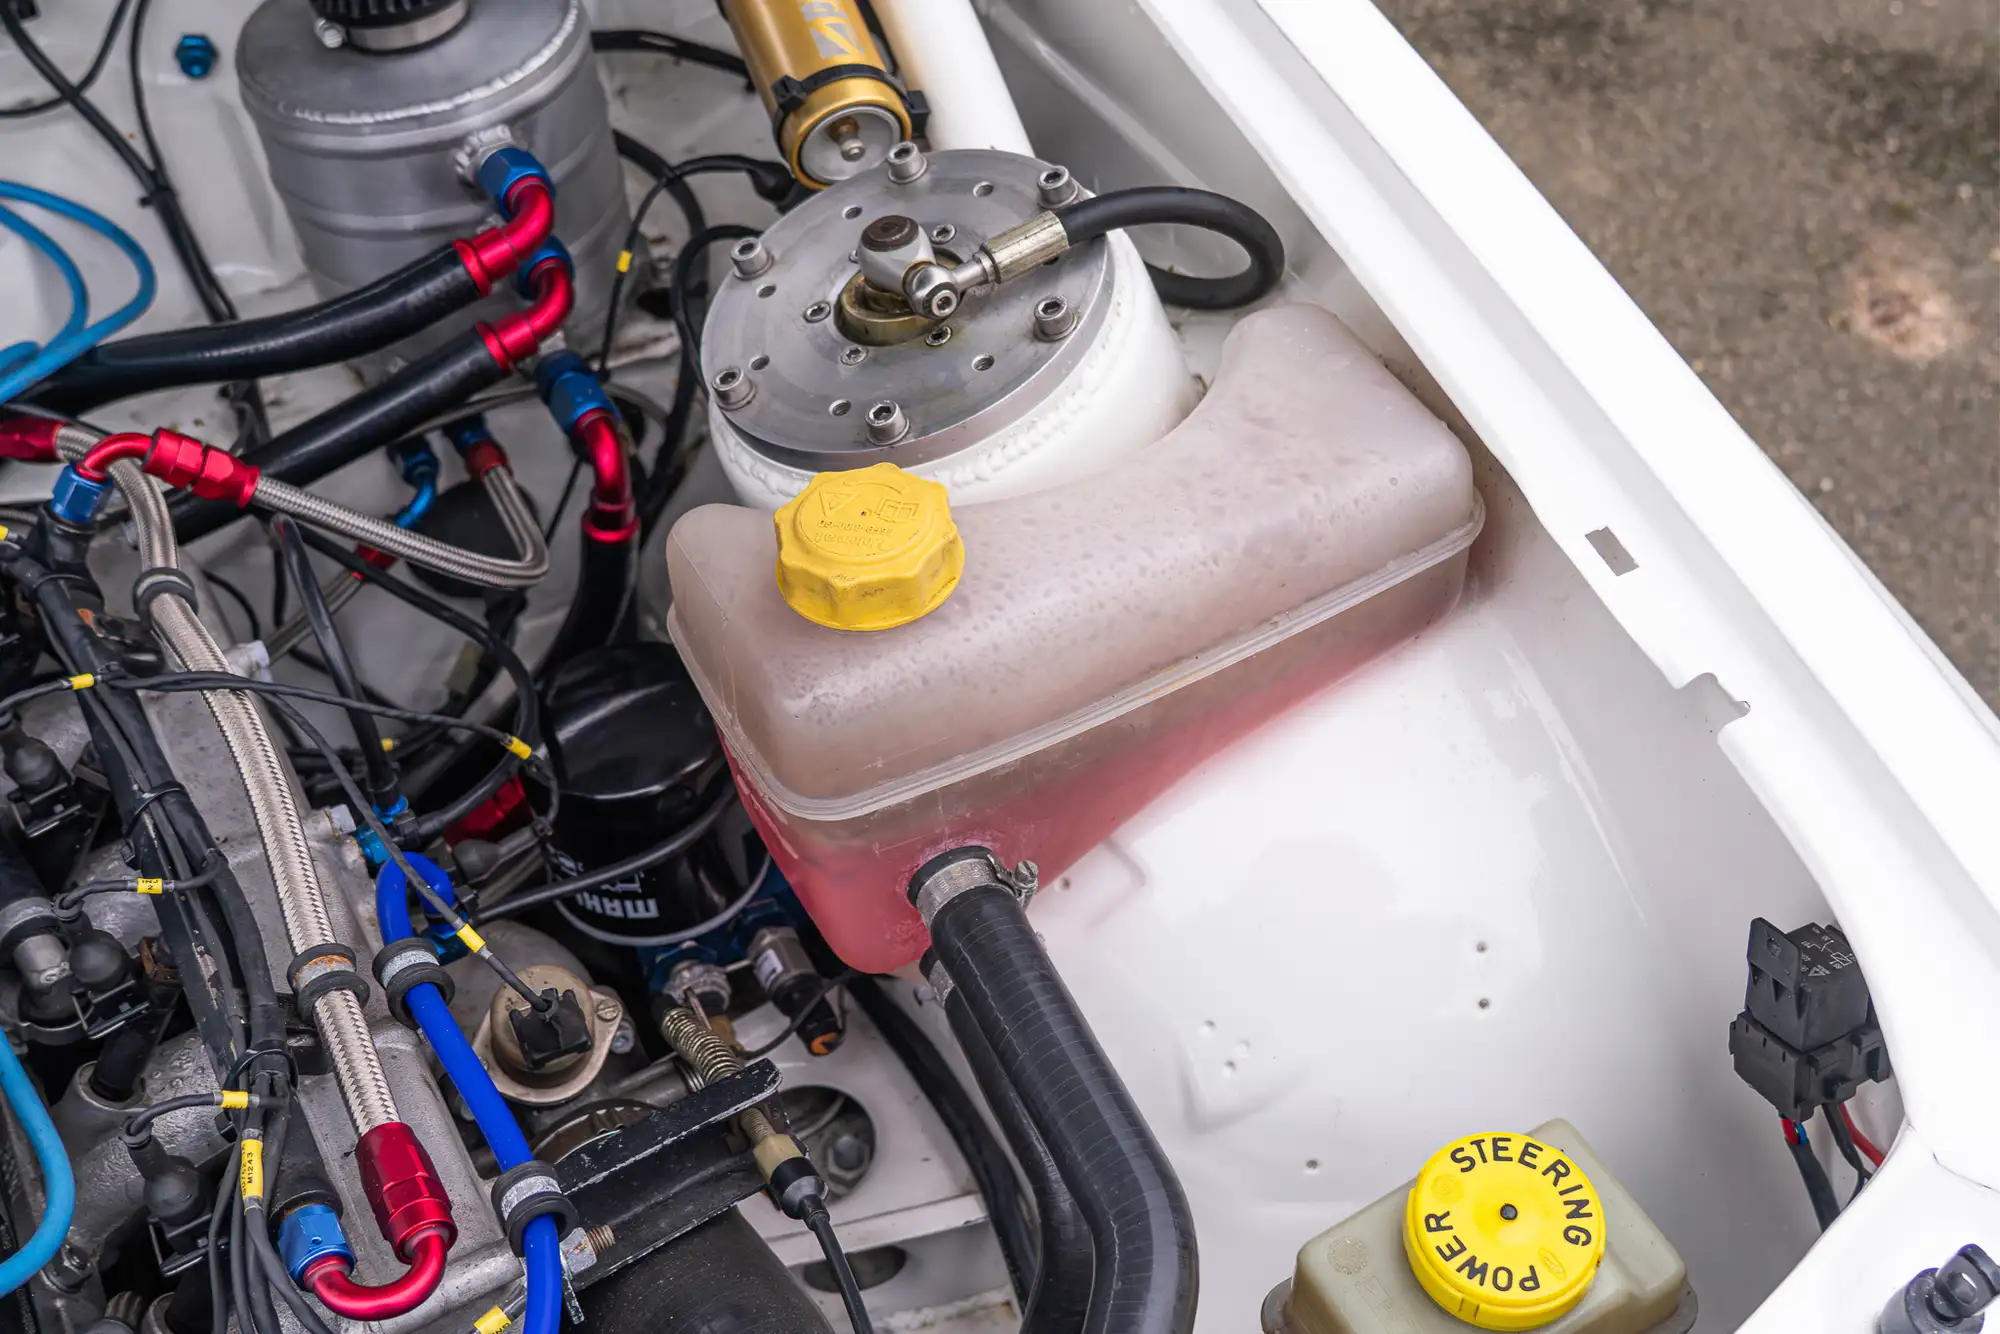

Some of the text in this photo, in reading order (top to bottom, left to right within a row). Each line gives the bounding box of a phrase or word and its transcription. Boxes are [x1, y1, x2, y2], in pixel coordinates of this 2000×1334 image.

[575, 891, 660, 919] MAH
[1424, 1137, 1593, 1292] POWER STEERING
